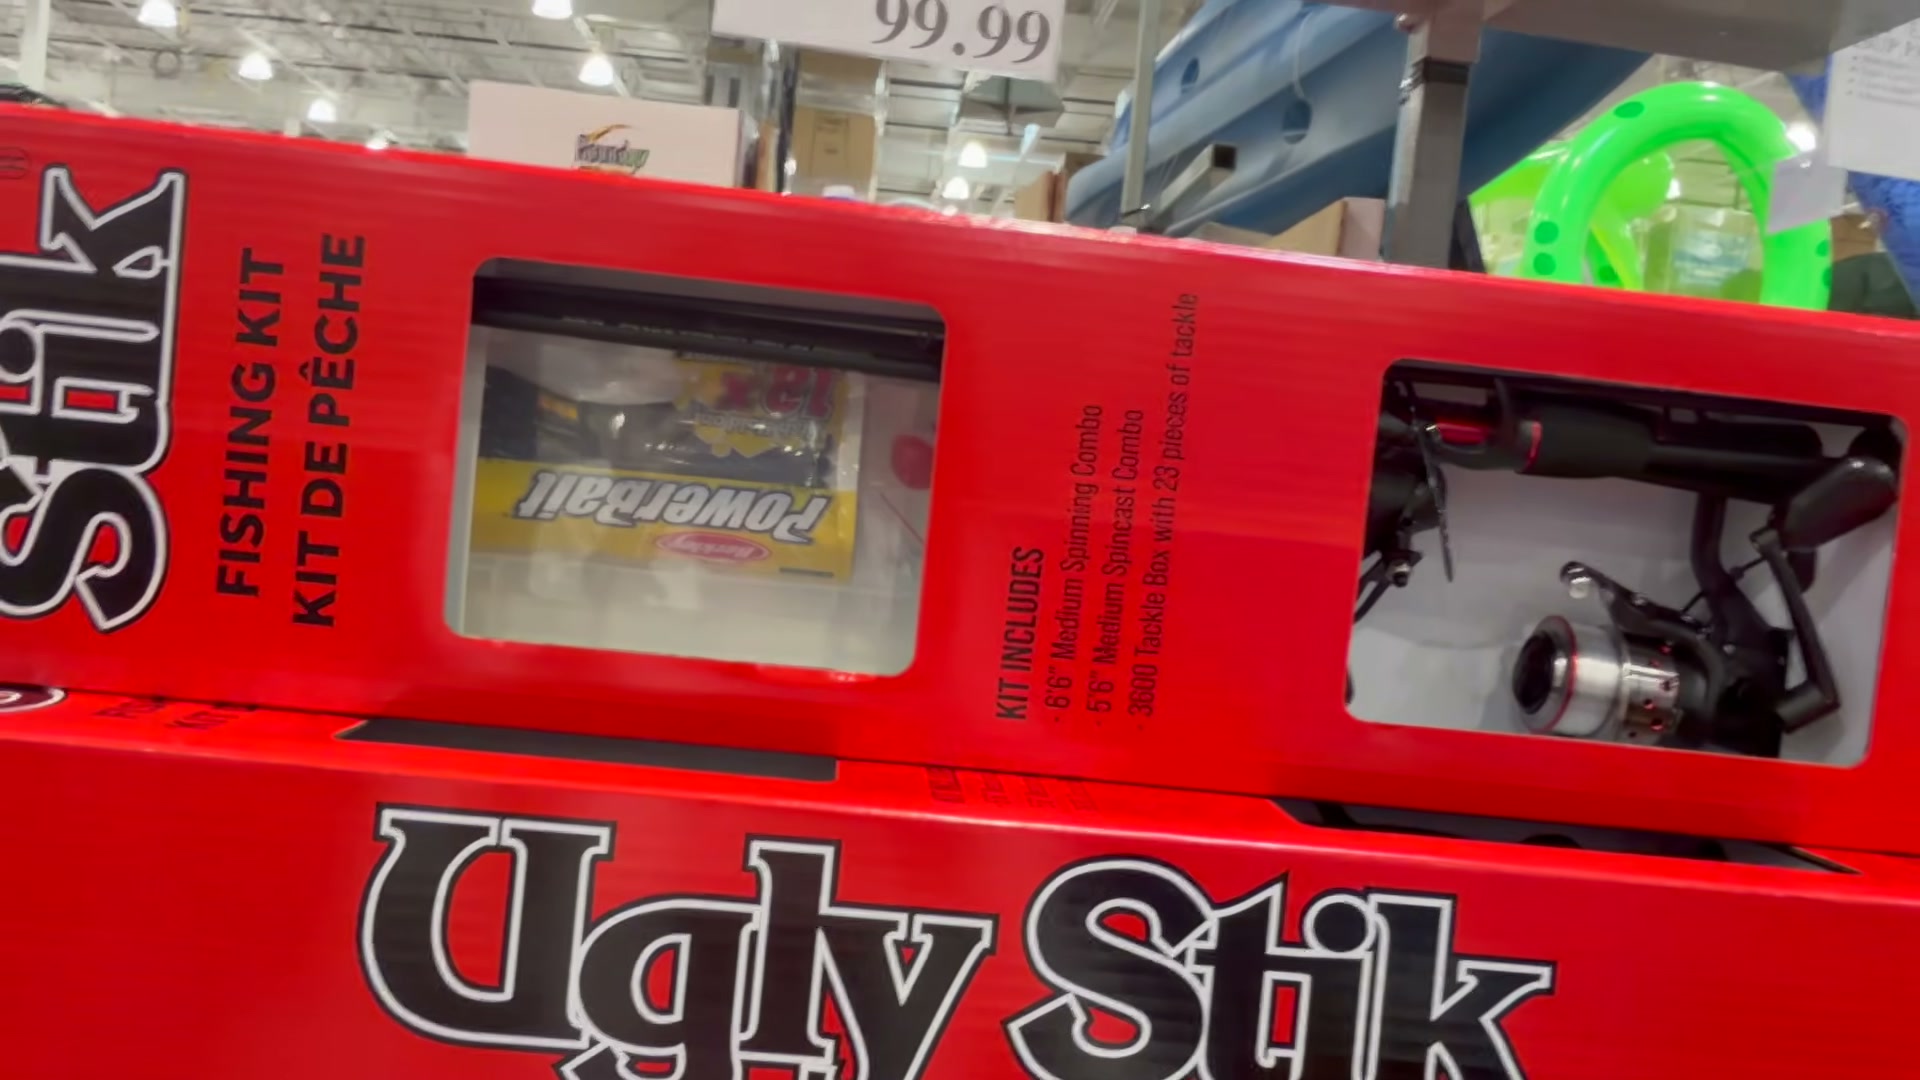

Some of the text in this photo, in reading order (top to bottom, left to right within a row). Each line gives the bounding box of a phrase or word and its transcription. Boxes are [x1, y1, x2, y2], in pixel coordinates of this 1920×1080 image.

[871, 0, 1050, 64] 99.99
[0, 163, 188, 632] Stik
[217, 247, 284, 597] FISHING KIT
[292, 234, 365, 627] KIT DE PÊCHE
[1070, 405, 1102, 478] Combo
[1112, 410, 1144, 482] Combo
[1060, 481, 1099, 573] Spinning
[1102, 487, 1136, 578] Spincast
[1128, 293, 1199, 717] 3600 Tackle Box with 23 pieces of tackle
[996, 546, 1045, 720] KIT INCLUDES
[1052, 579, 1085, 662] Medium
[1093, 583, 1124, 666] Medium
[356, 803, 1557, 1080] Ugly Stik
